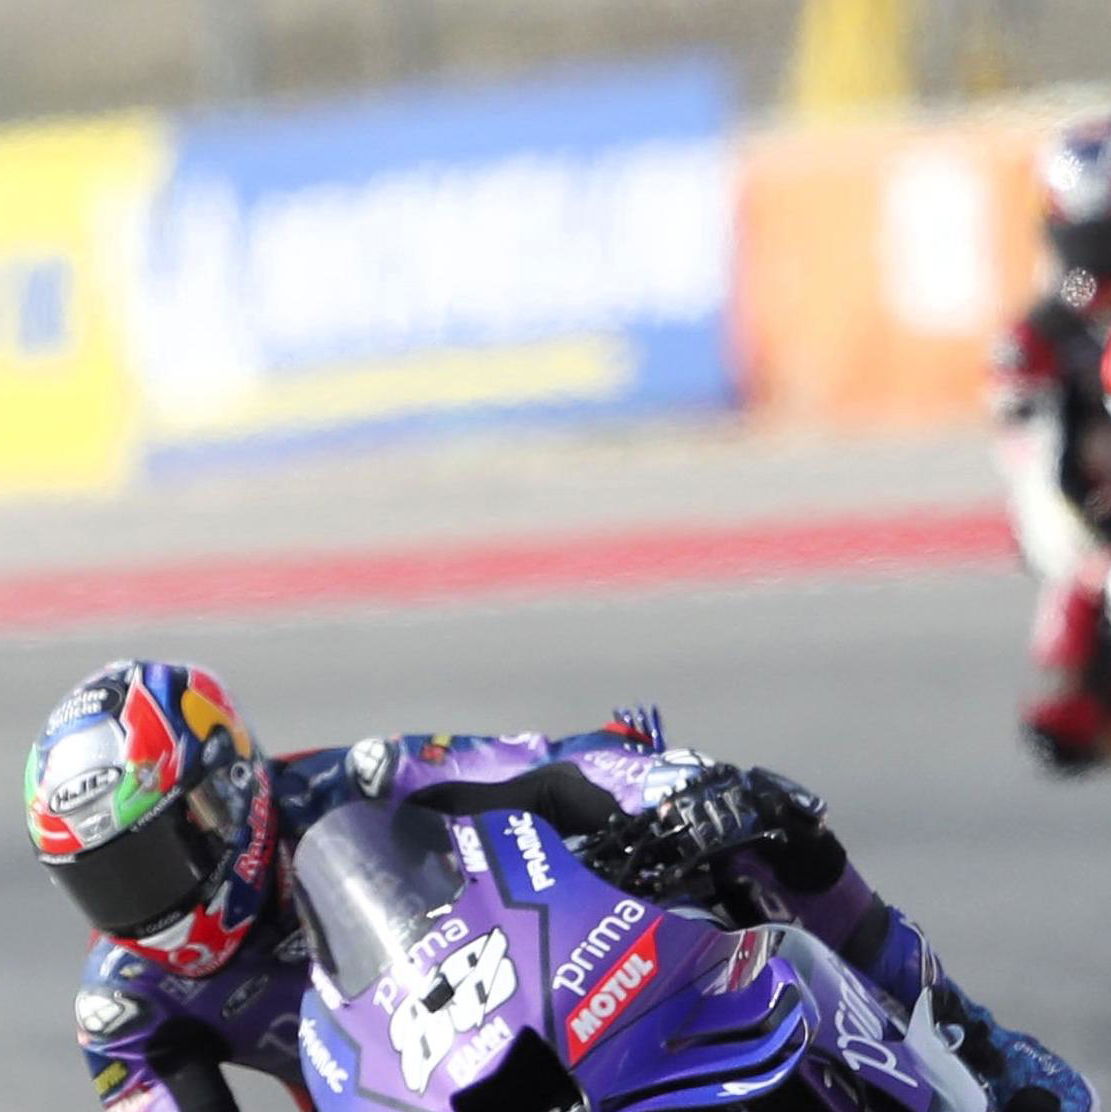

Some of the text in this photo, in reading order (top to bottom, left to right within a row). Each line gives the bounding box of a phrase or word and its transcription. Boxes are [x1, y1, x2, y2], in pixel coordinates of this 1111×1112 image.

[553, 899, 645, 996] prima
[390, 927, 518, 1094] 88
[570, 953, 654, 1043] MOTUL
